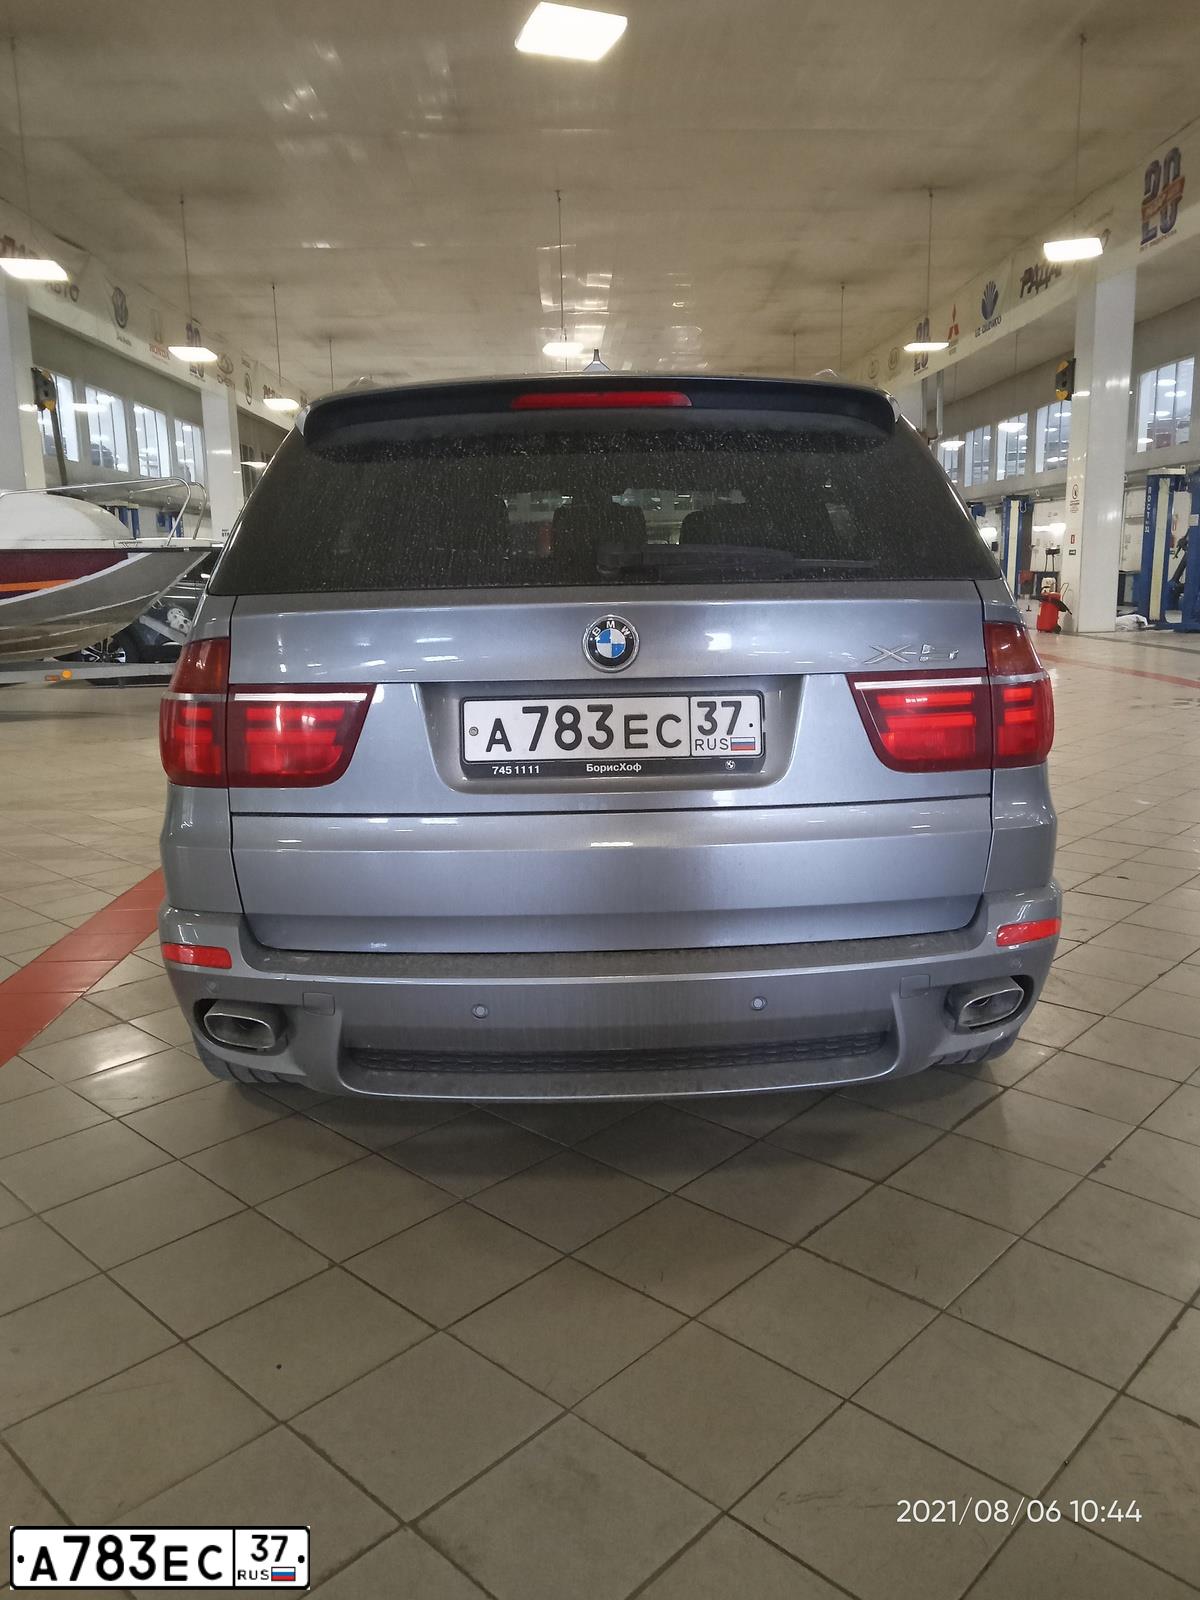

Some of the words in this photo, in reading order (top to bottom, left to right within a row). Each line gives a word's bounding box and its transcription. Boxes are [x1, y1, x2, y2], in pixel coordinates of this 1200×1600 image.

[592, 620, 631, 637] BMW
[697, 701, 742, 736] 37
[695, 738, 729, 751] RUS
[586, 763, 642, 773] БорисХоф
